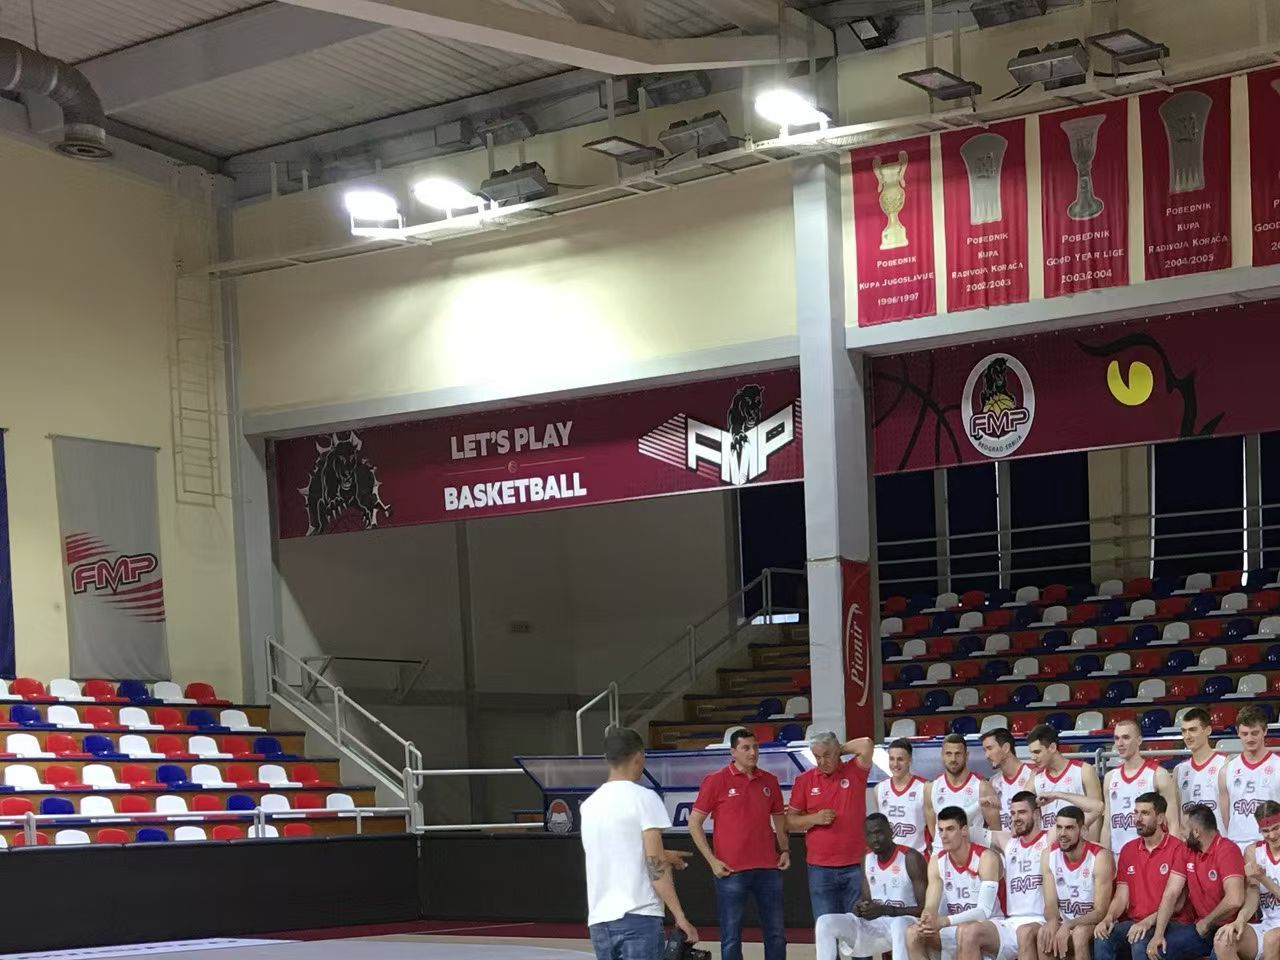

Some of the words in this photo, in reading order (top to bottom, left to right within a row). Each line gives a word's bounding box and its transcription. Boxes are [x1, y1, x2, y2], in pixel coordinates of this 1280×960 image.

[1164, 253, 1214, 268] 2004/2005
[1061, 268, 1112, 284] 2003/2004
[966, 279, 1012, 292] 2002/2003
[878, 292, 919, 306] 1996/1997
[970, 407, 1030, 440] FMP
[450, 430, 512, 461] LET'S
[514, 421, 574, 452] PLAY
[686, 402, 795, 487] FMP
[444, 472, 588, 511] BASKETBALL
[72, 553, 158, 594] FMP
[850, 619, 865, 689] Pionir
[1193, 784, 1201, 797] 2
[1246, 781, 1255, 794] 5
[1123, 797, 1131, 809] 3
[888, 805, 906, 818] 25
[1018, 860, 1032, 873] 12
[956, 887, 970, 899] 16
[1070, 885, 1080, 898] 3
